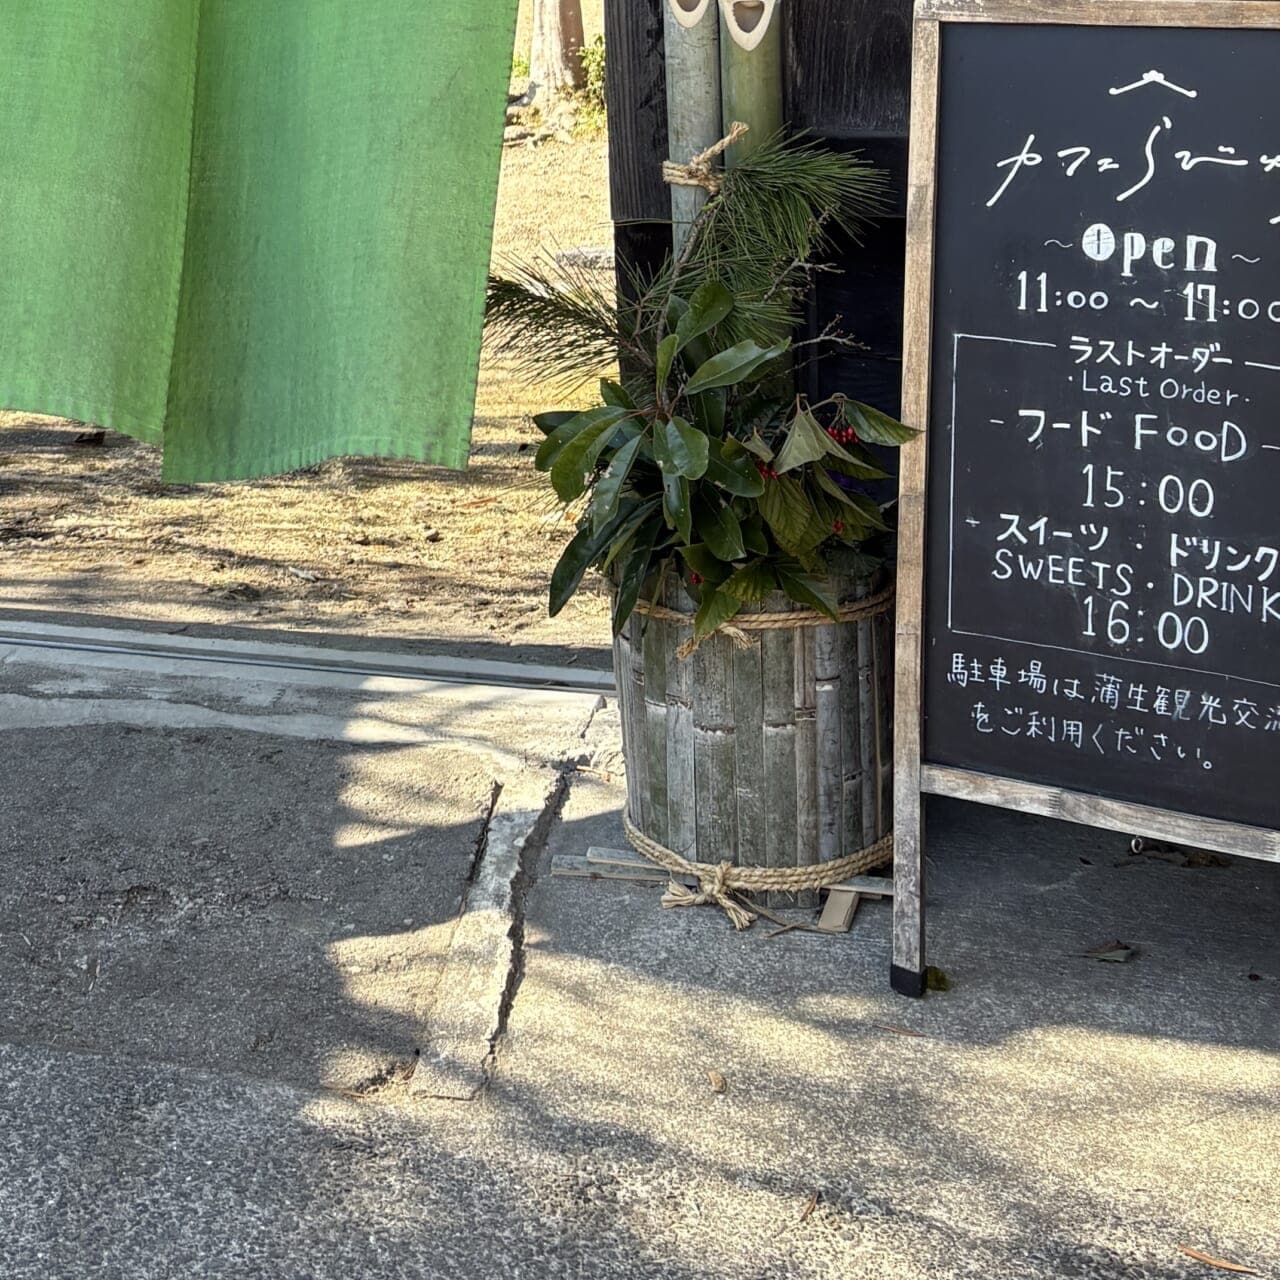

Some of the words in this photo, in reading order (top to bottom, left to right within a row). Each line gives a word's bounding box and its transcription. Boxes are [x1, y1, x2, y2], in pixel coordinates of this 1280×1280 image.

[1082, 223, 1217, 276] Open
[1017, 271, 1109, 313] 11:00
[1070, 335, 1233, 373] ラストオーダー
[1082, 370, 1150, 398] Last
[1159, 378, 1239, 407] Order
[1018, 410, 1112, 448] フード
[1082, 463, 1215, 518] 15:00
[996, 513, 1109, 551] スイーツ
[1169, 532, 1279, 583] ドリンク
[991, 548, 1134, 597] SWEETS
[1172, 572, 1280, 623] DRINK
[1082, 595, 1210, 655] 16:00
